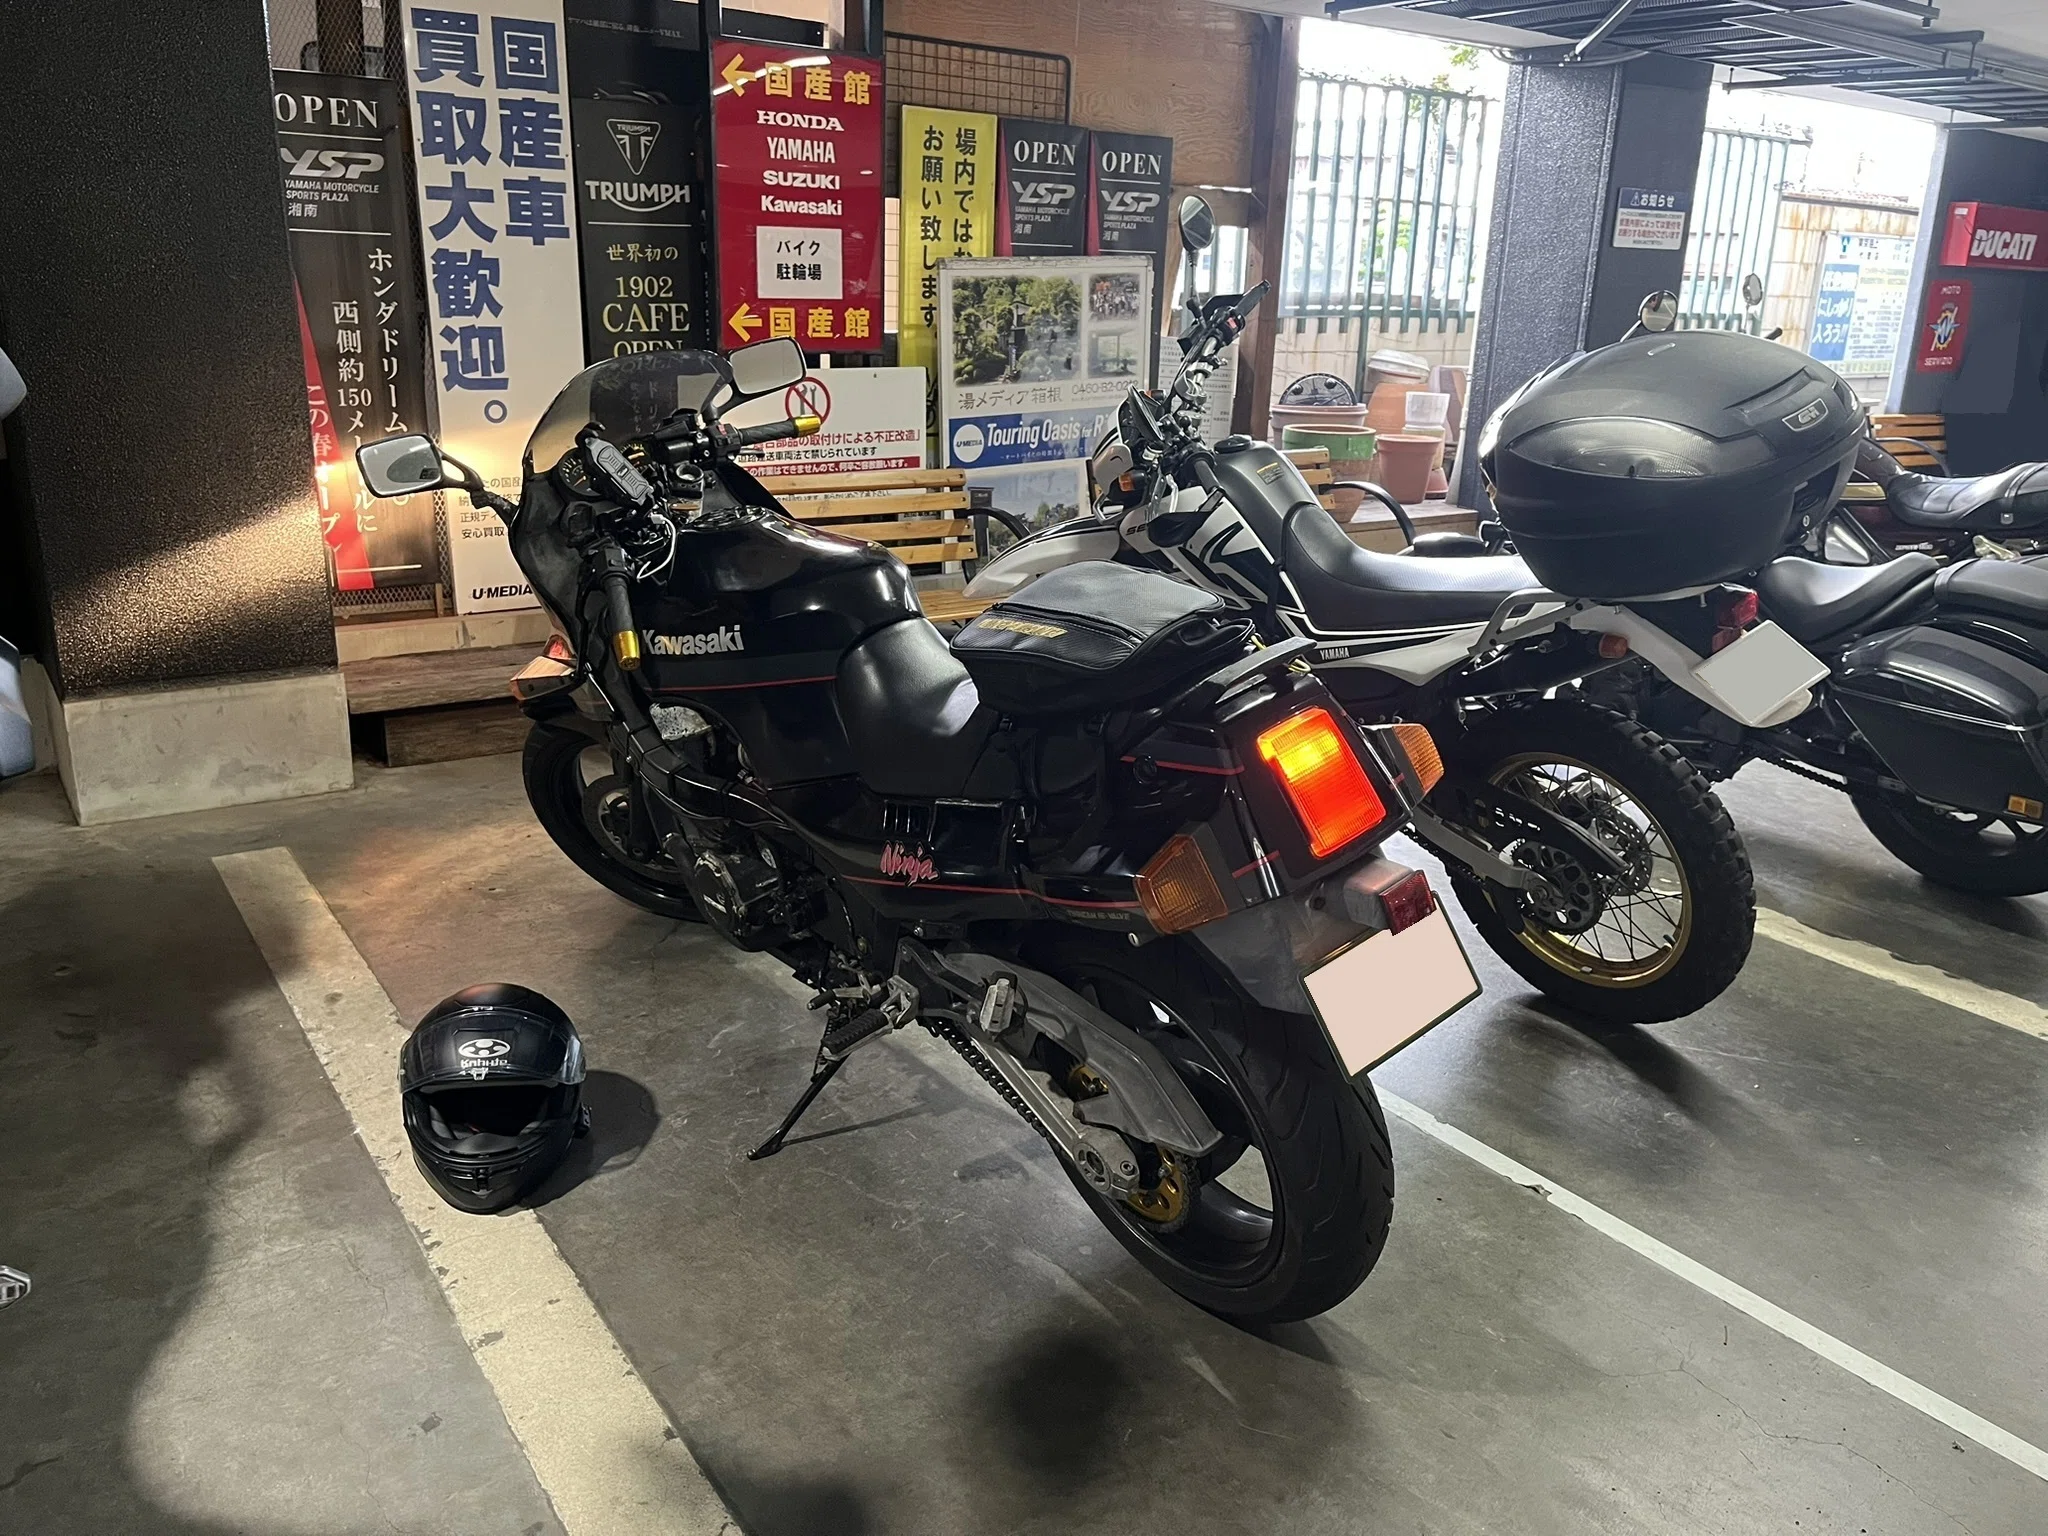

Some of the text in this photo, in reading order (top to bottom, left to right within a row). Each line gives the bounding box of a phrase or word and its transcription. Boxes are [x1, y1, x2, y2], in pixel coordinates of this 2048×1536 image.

[765, 62, 870, 105] 国産館
[274, 93, 378, 128] OPEN
[757, 110, 844, 131] HONDA
[491, 16, 570, 245] 国産車
[617, 123, 651, 134] TRIUMPH
[767, 137, 836, 164] YAMAHA
[1014, 140, 1076, 165] OPEN
[280, 148, 385, 179] YSP
[1102, 151, 1162, 175] OPEN
[284, 179, 380, 194] YAMAHA MOTORCYCLE
[763, 170, 841, 190] SUZUKI
[286, 190, 349, 202] SPORTS PLAZA
[585, 180, 691, 212] TRIUMPH
[1012, 181, 1076, 205] YSP
[1101, 190, 1160, 213] YSP
[1640, 193, 1675, 208] お知らせ
[287, 202, 318, 218] 湘南
[411, 8, 509, 423] 買取大歓迎。
[761, 195, 842, 216] Kawasaki
[606, 243, 680, 263] 世界初の
[776, 240, 820, 256] バイク
[1971, 228, 2038, 261] DUCATI
[776, 263, 822, 281] 駐輪場
[616, 276, 674, 298] 1902
[1940, 285, 1962, 295] MOTO
[602, 303, 690, 333] CAFE
[769, 307, 870, 339] 国産館
[1924, 356, 1953, 367] SERVIZIO
[368, 247, 412, 505] ホンダドリーム
[958, 387, 1063, 411] 湯メディア箱根
[331, 300, 377, 533] 西側約150メルに
[987, 420, 1041, 449] Touring
[1042, 418, 1080, 442] Oasis
[1081, 427, 1093, 438] for
[462, 526, 506, 539] 安心買取
[1126, 523, 1147, 536] SE
[642, 624, 744, 655] Kawasaki
[1320, 647, 1350, 660] YAMAHA
[880, 840, 940, 887] Ninja
